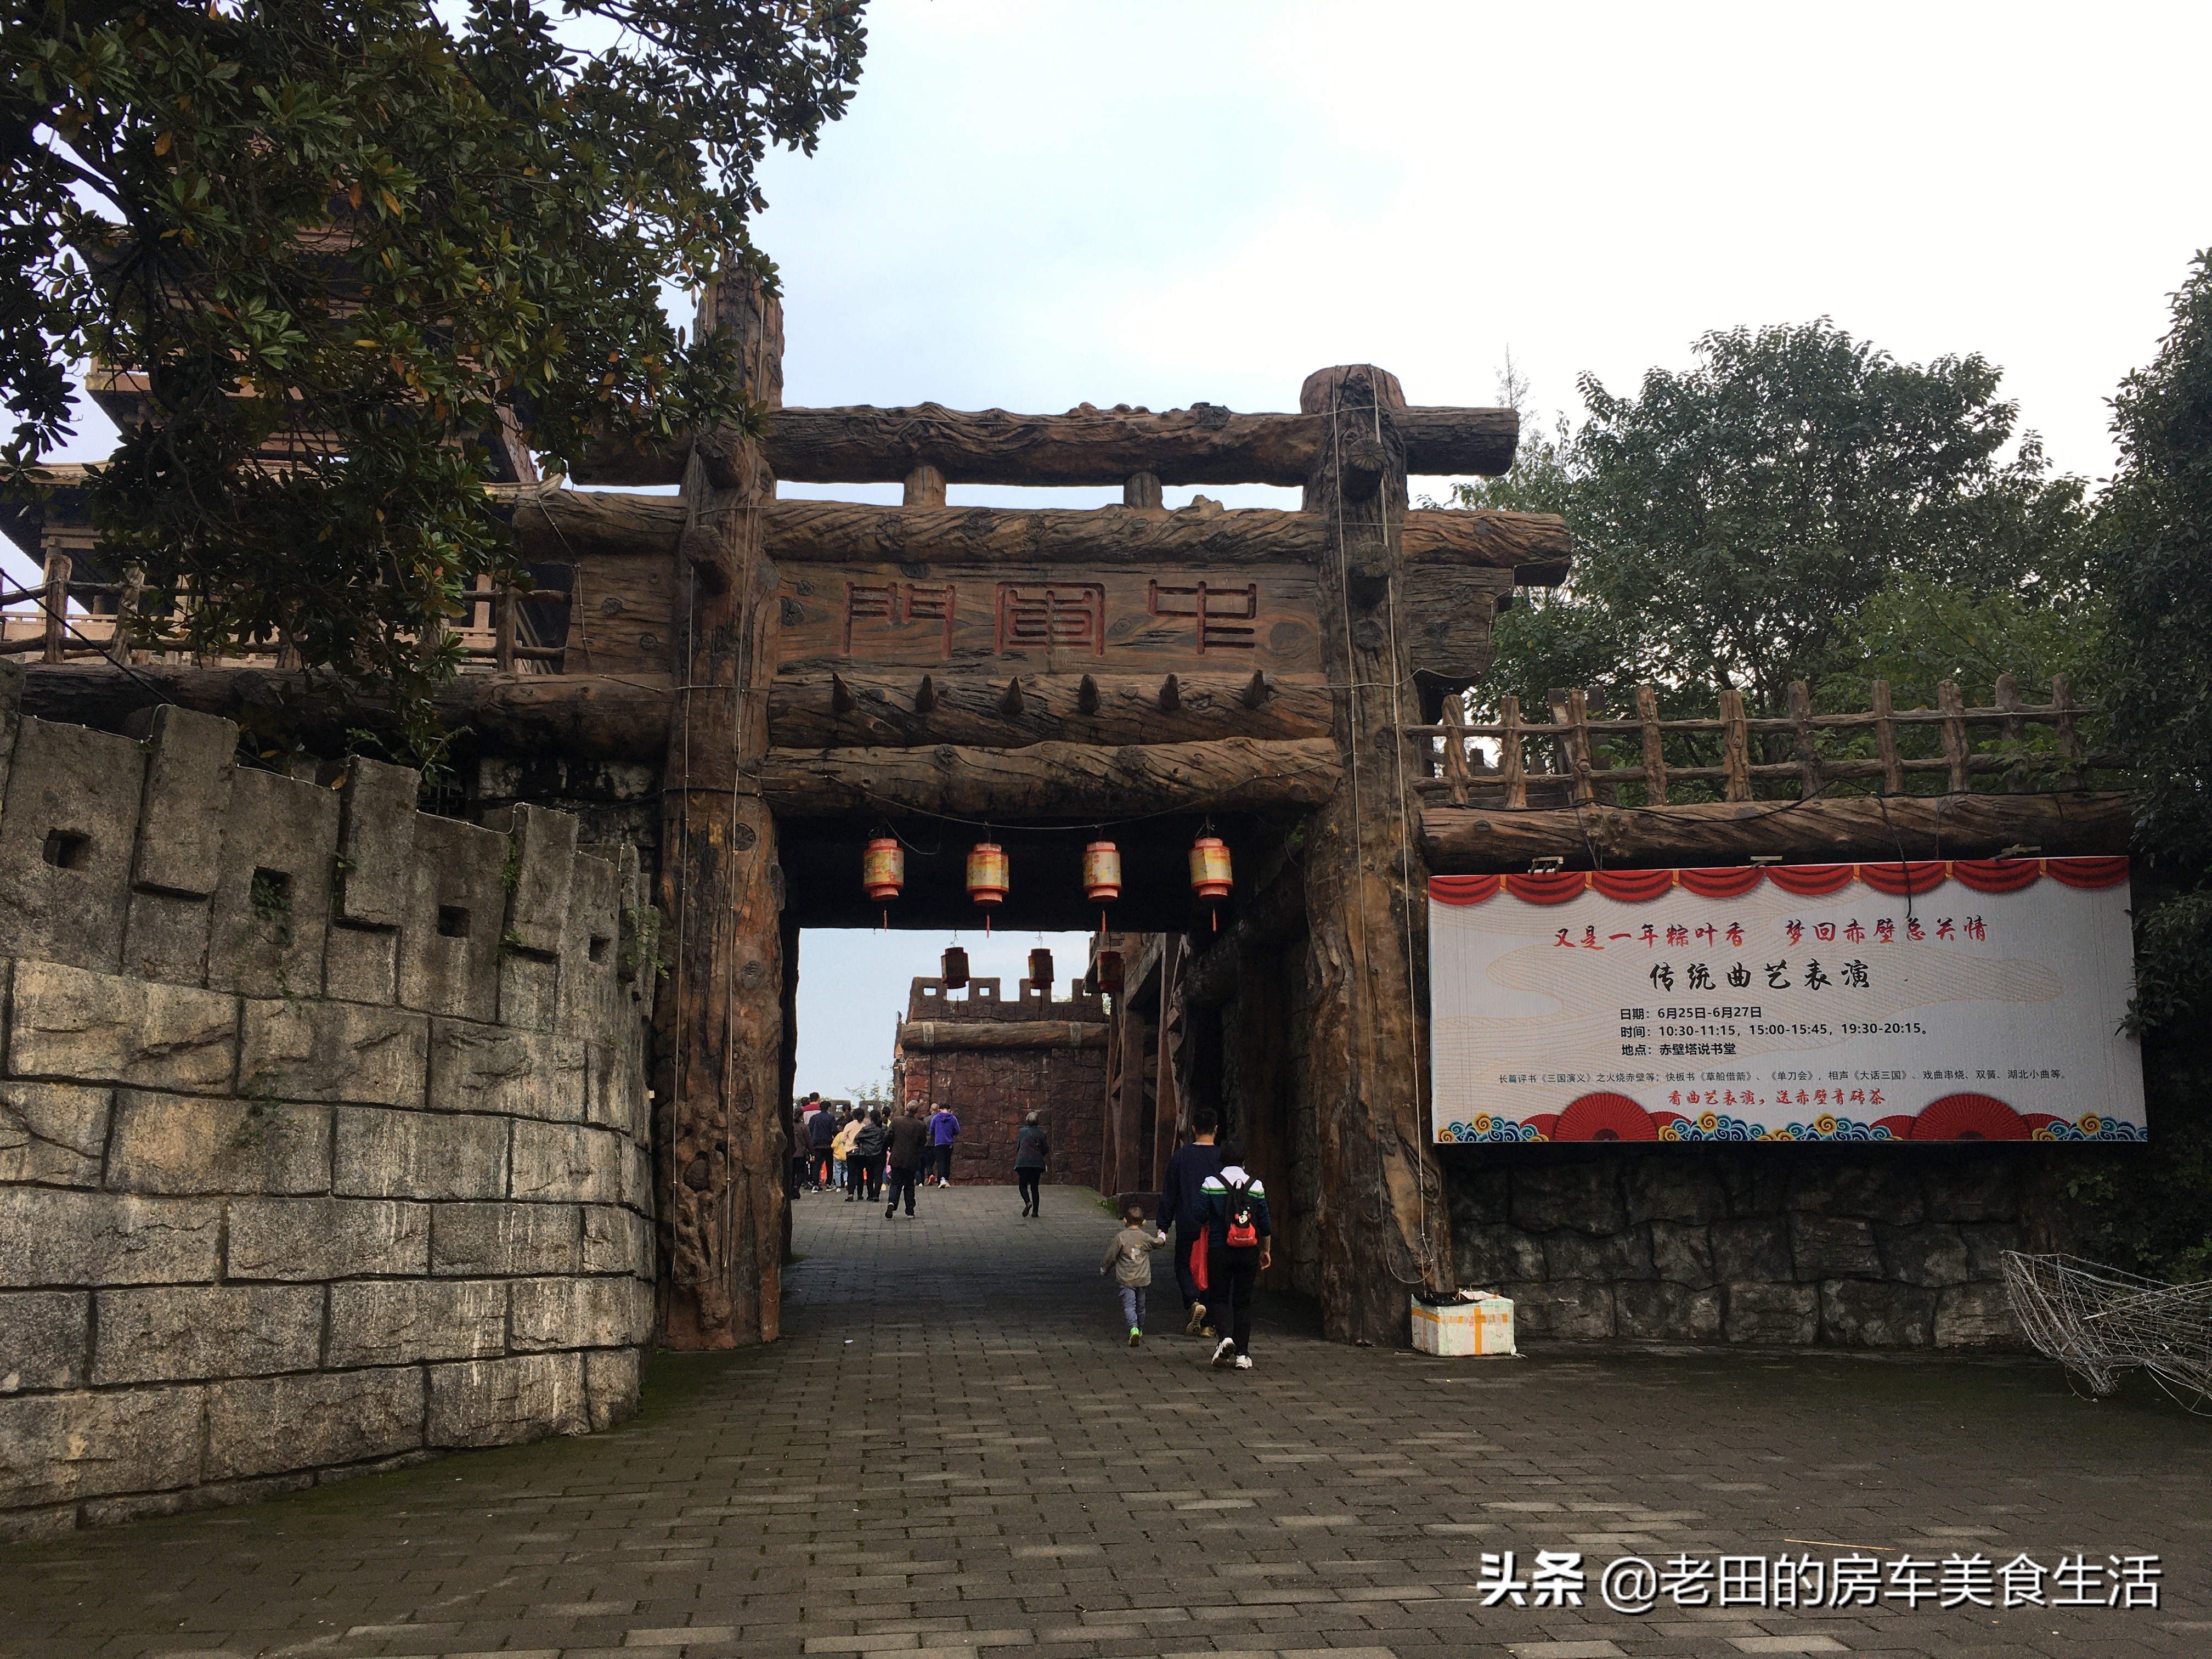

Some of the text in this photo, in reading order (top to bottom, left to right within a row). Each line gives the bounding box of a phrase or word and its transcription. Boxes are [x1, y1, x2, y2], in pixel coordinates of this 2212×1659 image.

[1553, 914, 1988, 951] 又是一年粽叶香 梦回赤壁总关情
[1649, 958, 1871, 992] 传统曲艺表演
[1621, 1042, 1738, 1057] 地点：赤壁塔说书堂
